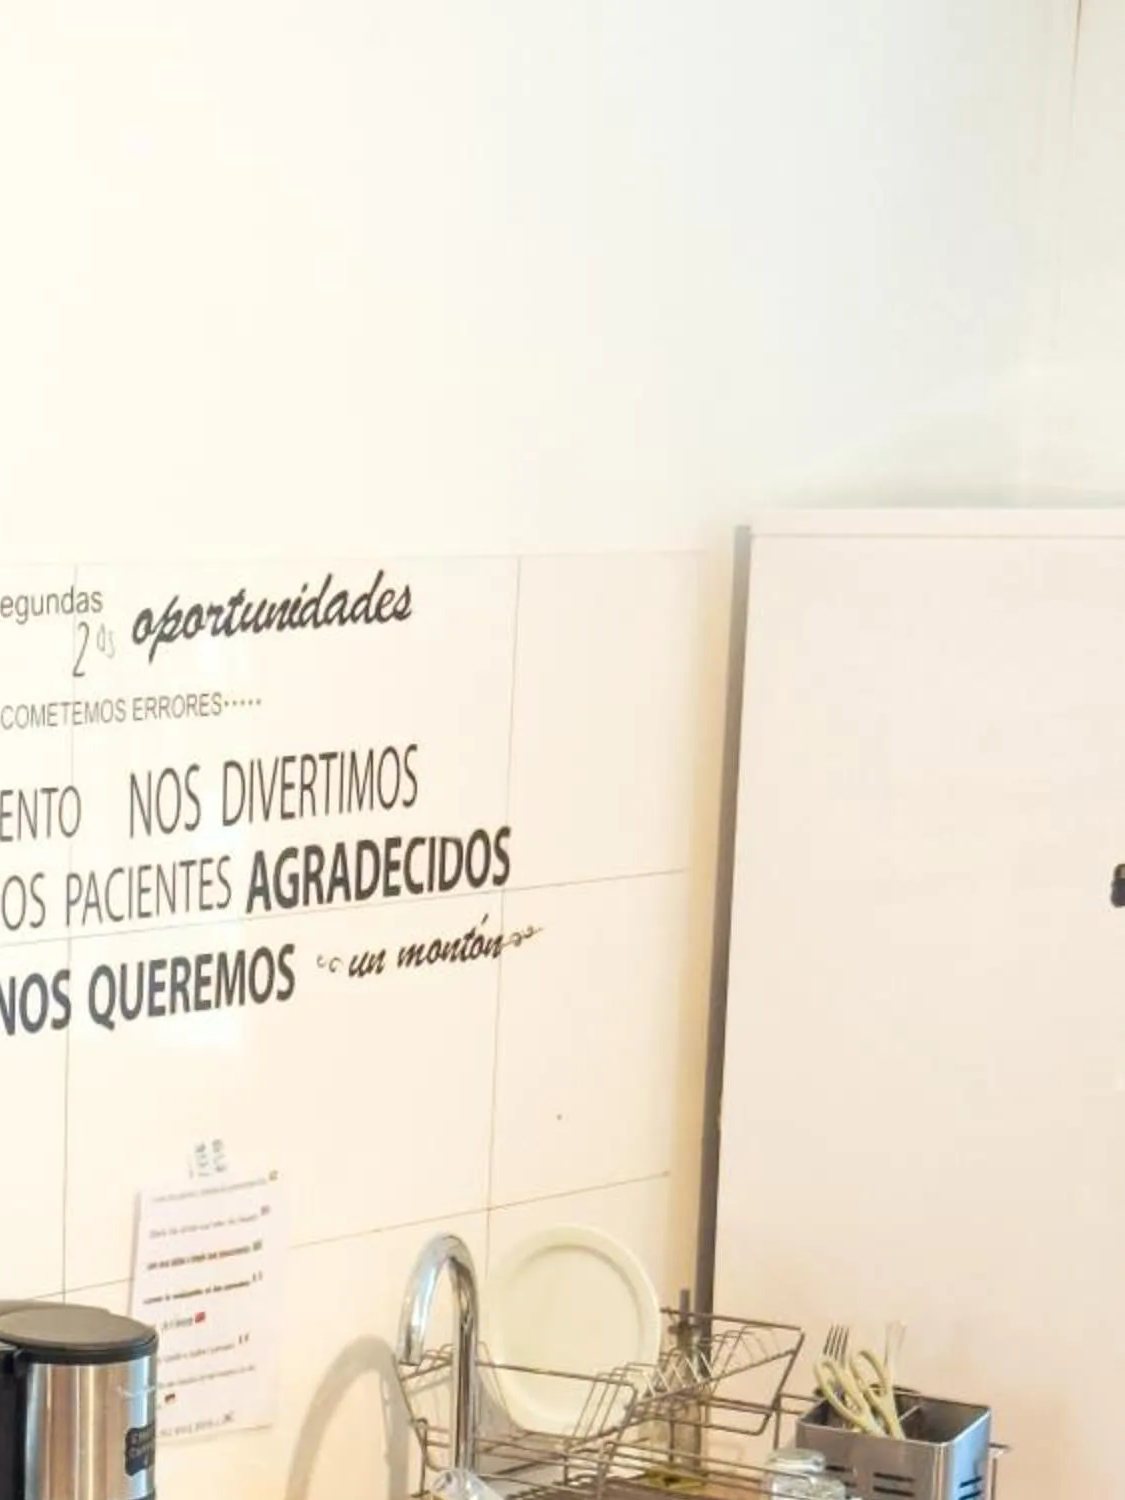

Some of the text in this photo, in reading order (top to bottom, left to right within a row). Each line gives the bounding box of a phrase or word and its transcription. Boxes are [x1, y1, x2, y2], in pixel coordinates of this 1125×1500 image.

[131, 569, 413, 664] oportunidades
[129, 743, 419, 840] NOS DIVERTIMOS
[65, 855, 233, 928] PACIENTES
[245, 826, 512, 914] AGRADECIDOS
[87, 943, 297, 1030] QUEREMOS
[347, 913, 506, 979] un montón
